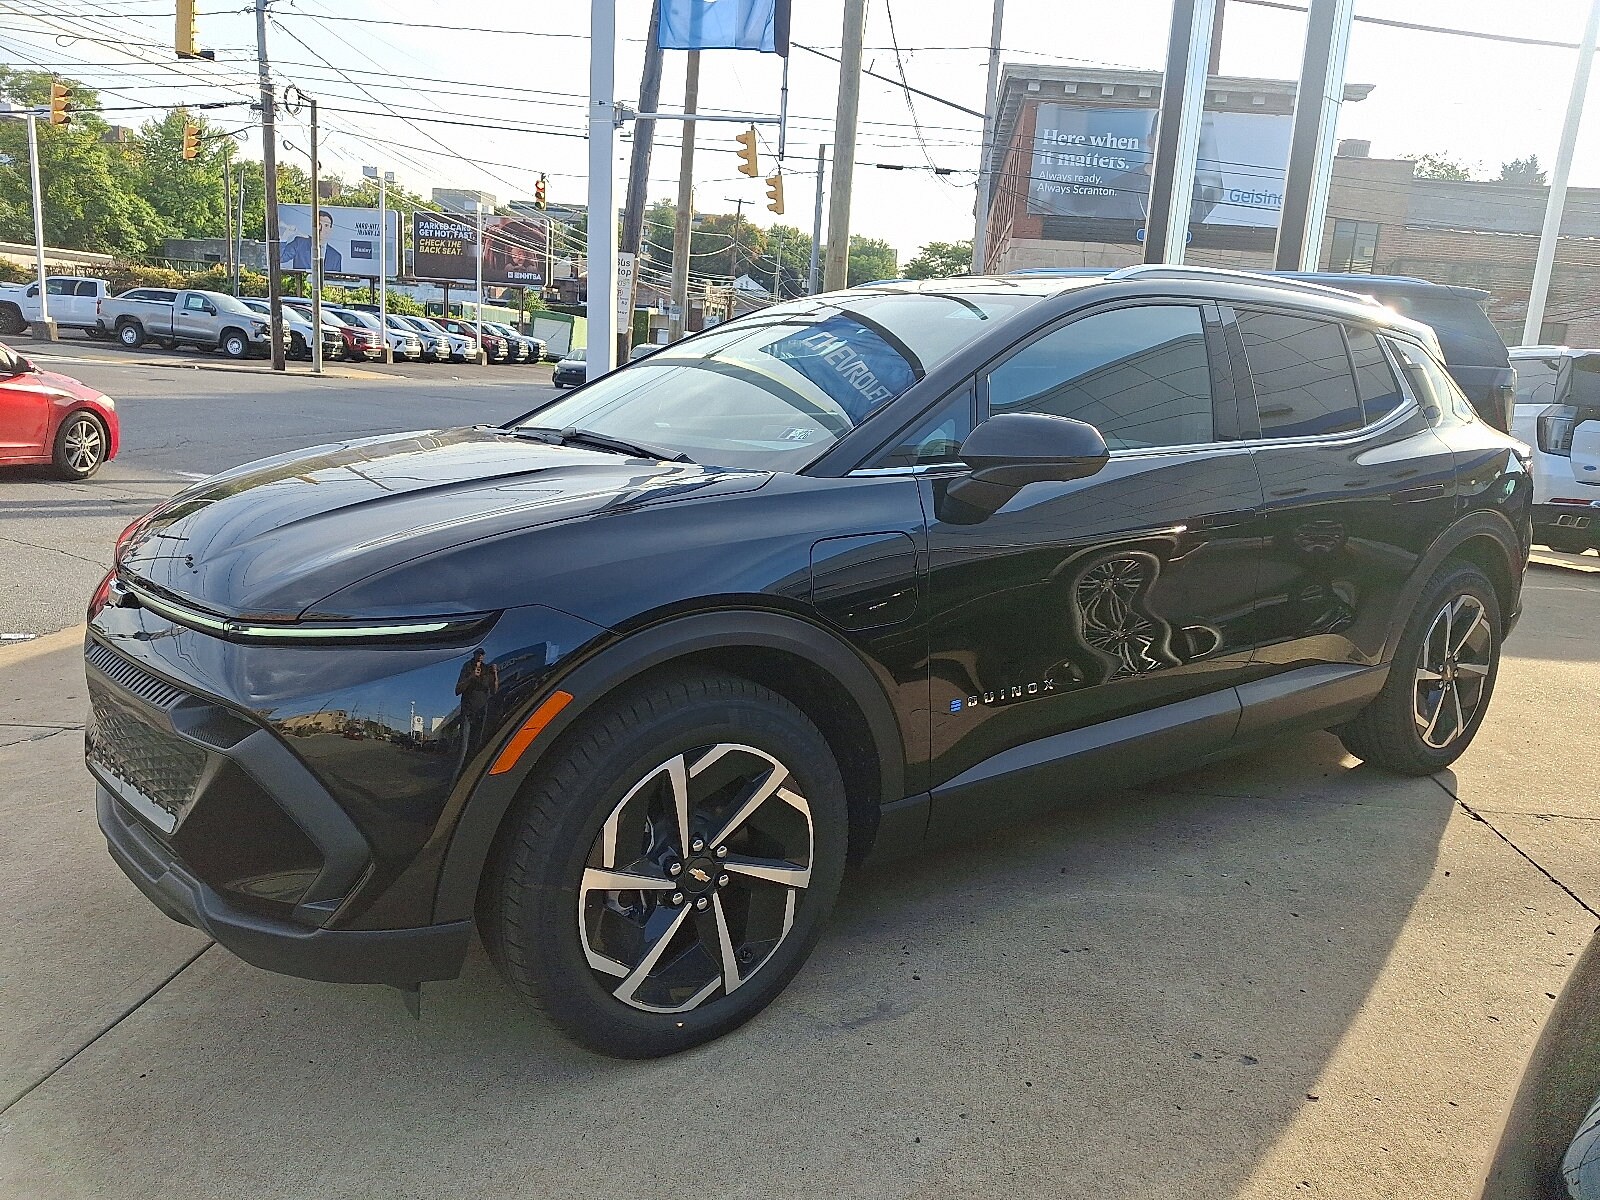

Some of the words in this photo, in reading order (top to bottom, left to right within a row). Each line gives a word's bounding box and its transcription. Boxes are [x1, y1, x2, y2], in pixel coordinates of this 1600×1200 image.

[1042, 129, 1085, 147] Here
[1090, 132, 1140, 150] when
[1040, 149, 1053, 165] it
[1057, 152, 1130, 169] matters.
[1039, 170, 1072, 182] Always
[1074, 174, 1103, 185] ready.
[1036, 182, 1071, 195] Always
[1072, 184, 1118, 196] Scranton.
[419, 222, 449, 231] PARKED
[419, 229, 434, 237] GET
[435, 230, 453, 239] HOT,
[419, 239, 446, 247] CHECK
[448, 240, 462, 248] THE
[419, 246, 442, 254] BACK
[442, 247, 463, 256] SEAT.
[617, 267, 632, 278] top
[801, 331, 895, 405] CHEVROLET
